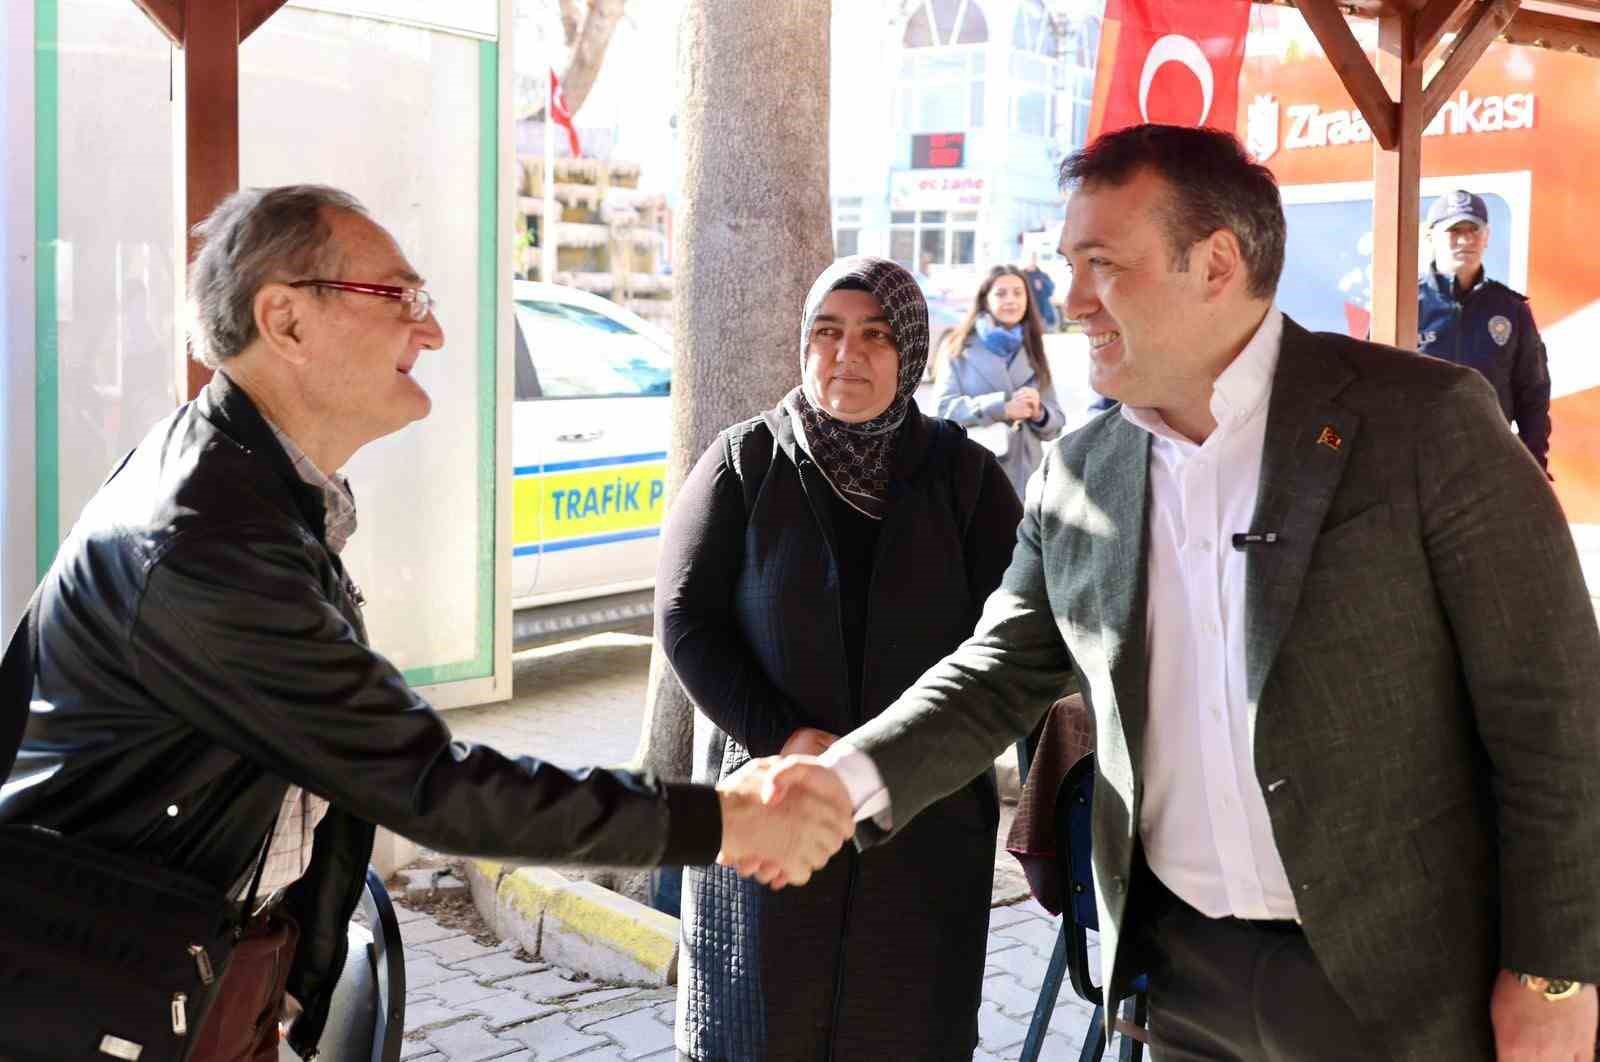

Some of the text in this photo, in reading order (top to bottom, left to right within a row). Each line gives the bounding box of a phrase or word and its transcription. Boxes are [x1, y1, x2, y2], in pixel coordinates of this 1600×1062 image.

[1285, 90, 1535, 149] Ziraa nkası
[552, 476, 664, 520] TRAFİK P
